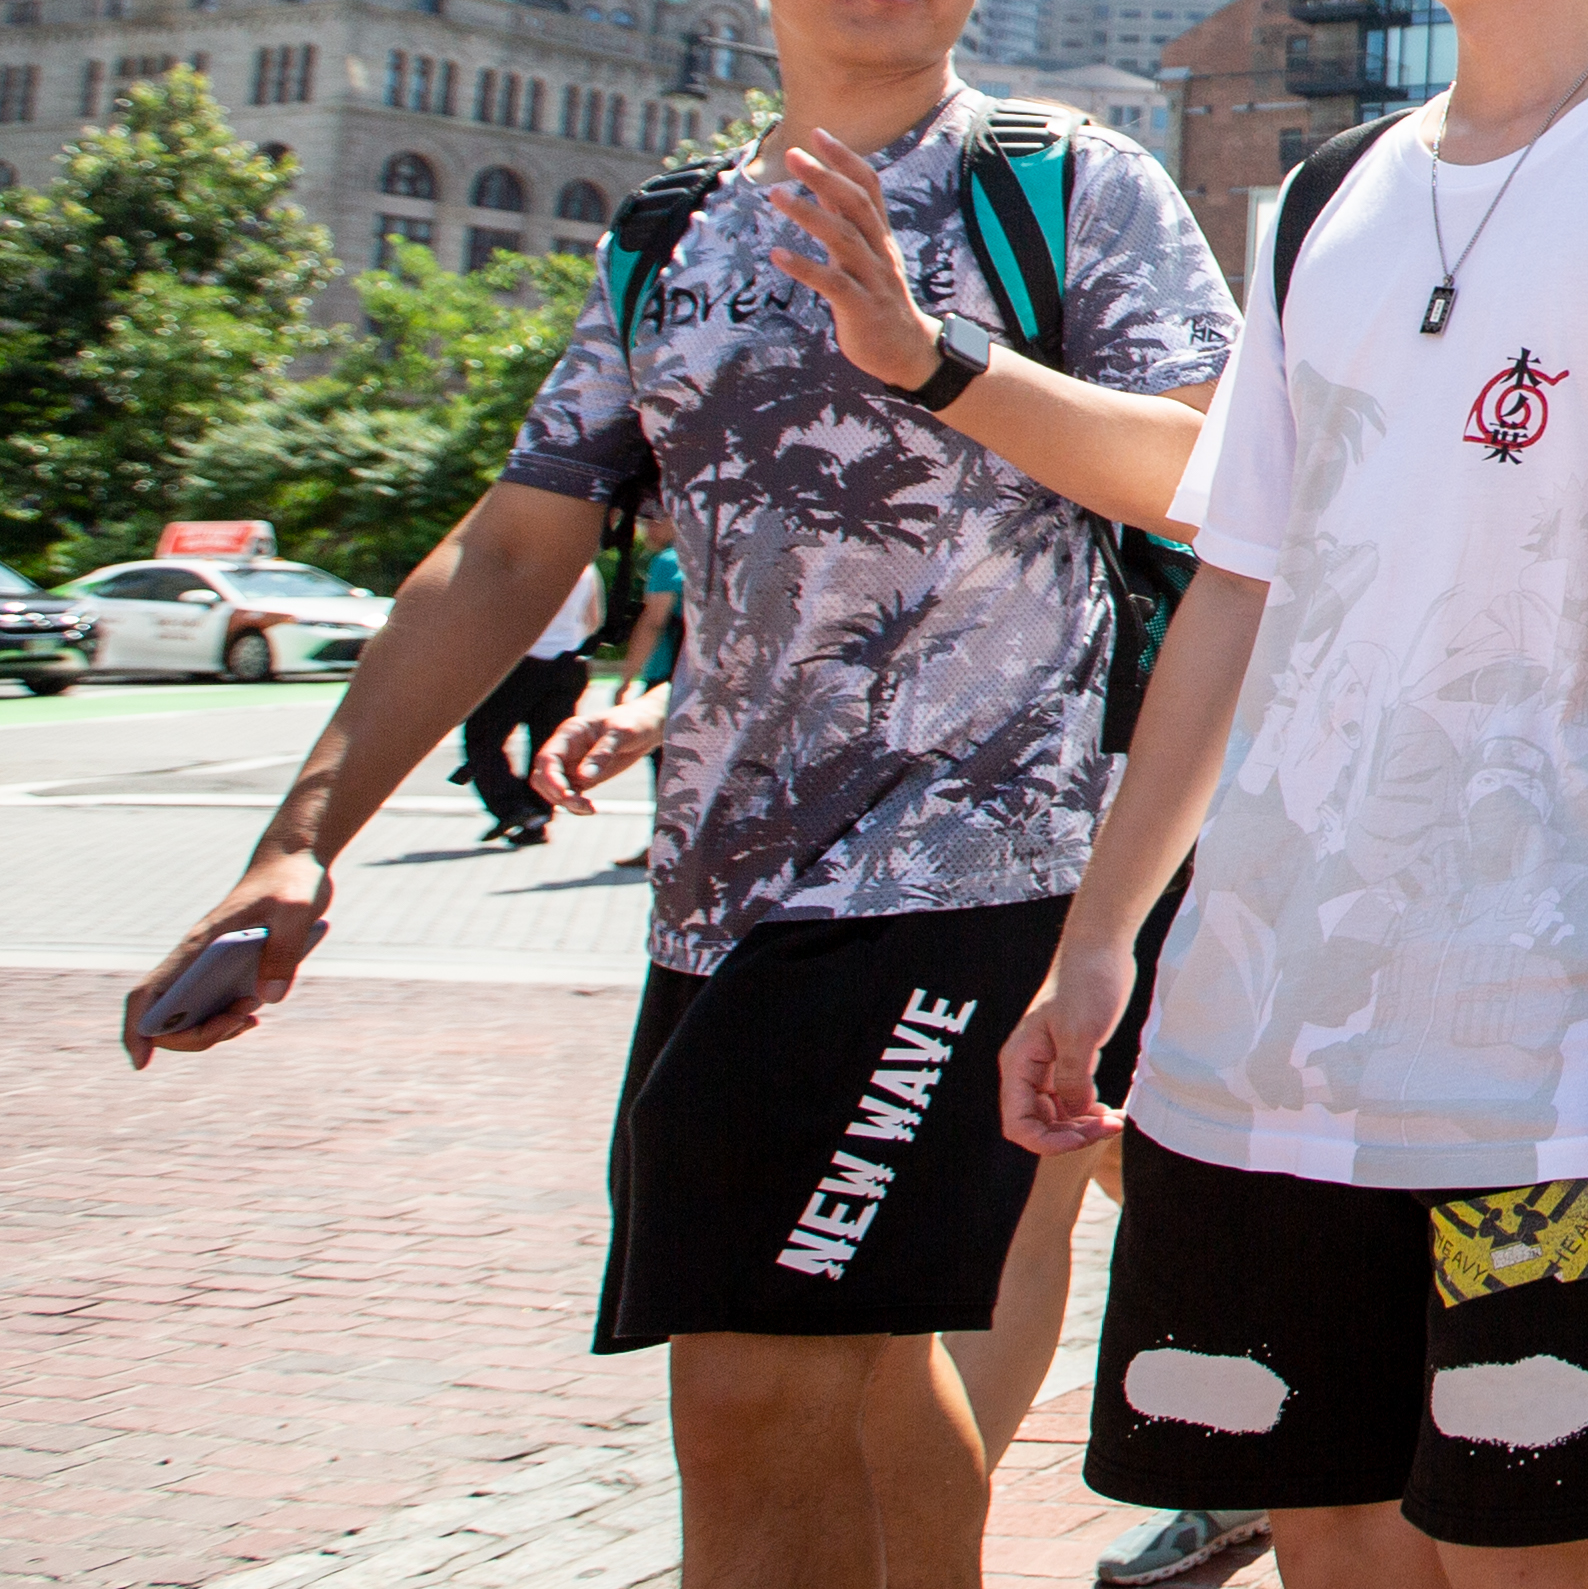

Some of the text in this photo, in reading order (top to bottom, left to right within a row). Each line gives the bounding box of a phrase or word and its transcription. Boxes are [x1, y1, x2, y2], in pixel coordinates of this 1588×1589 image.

[774, 987, 978, 1282] NEW WAVE
[1435, 1228, 1489, 1282] HEAVY
